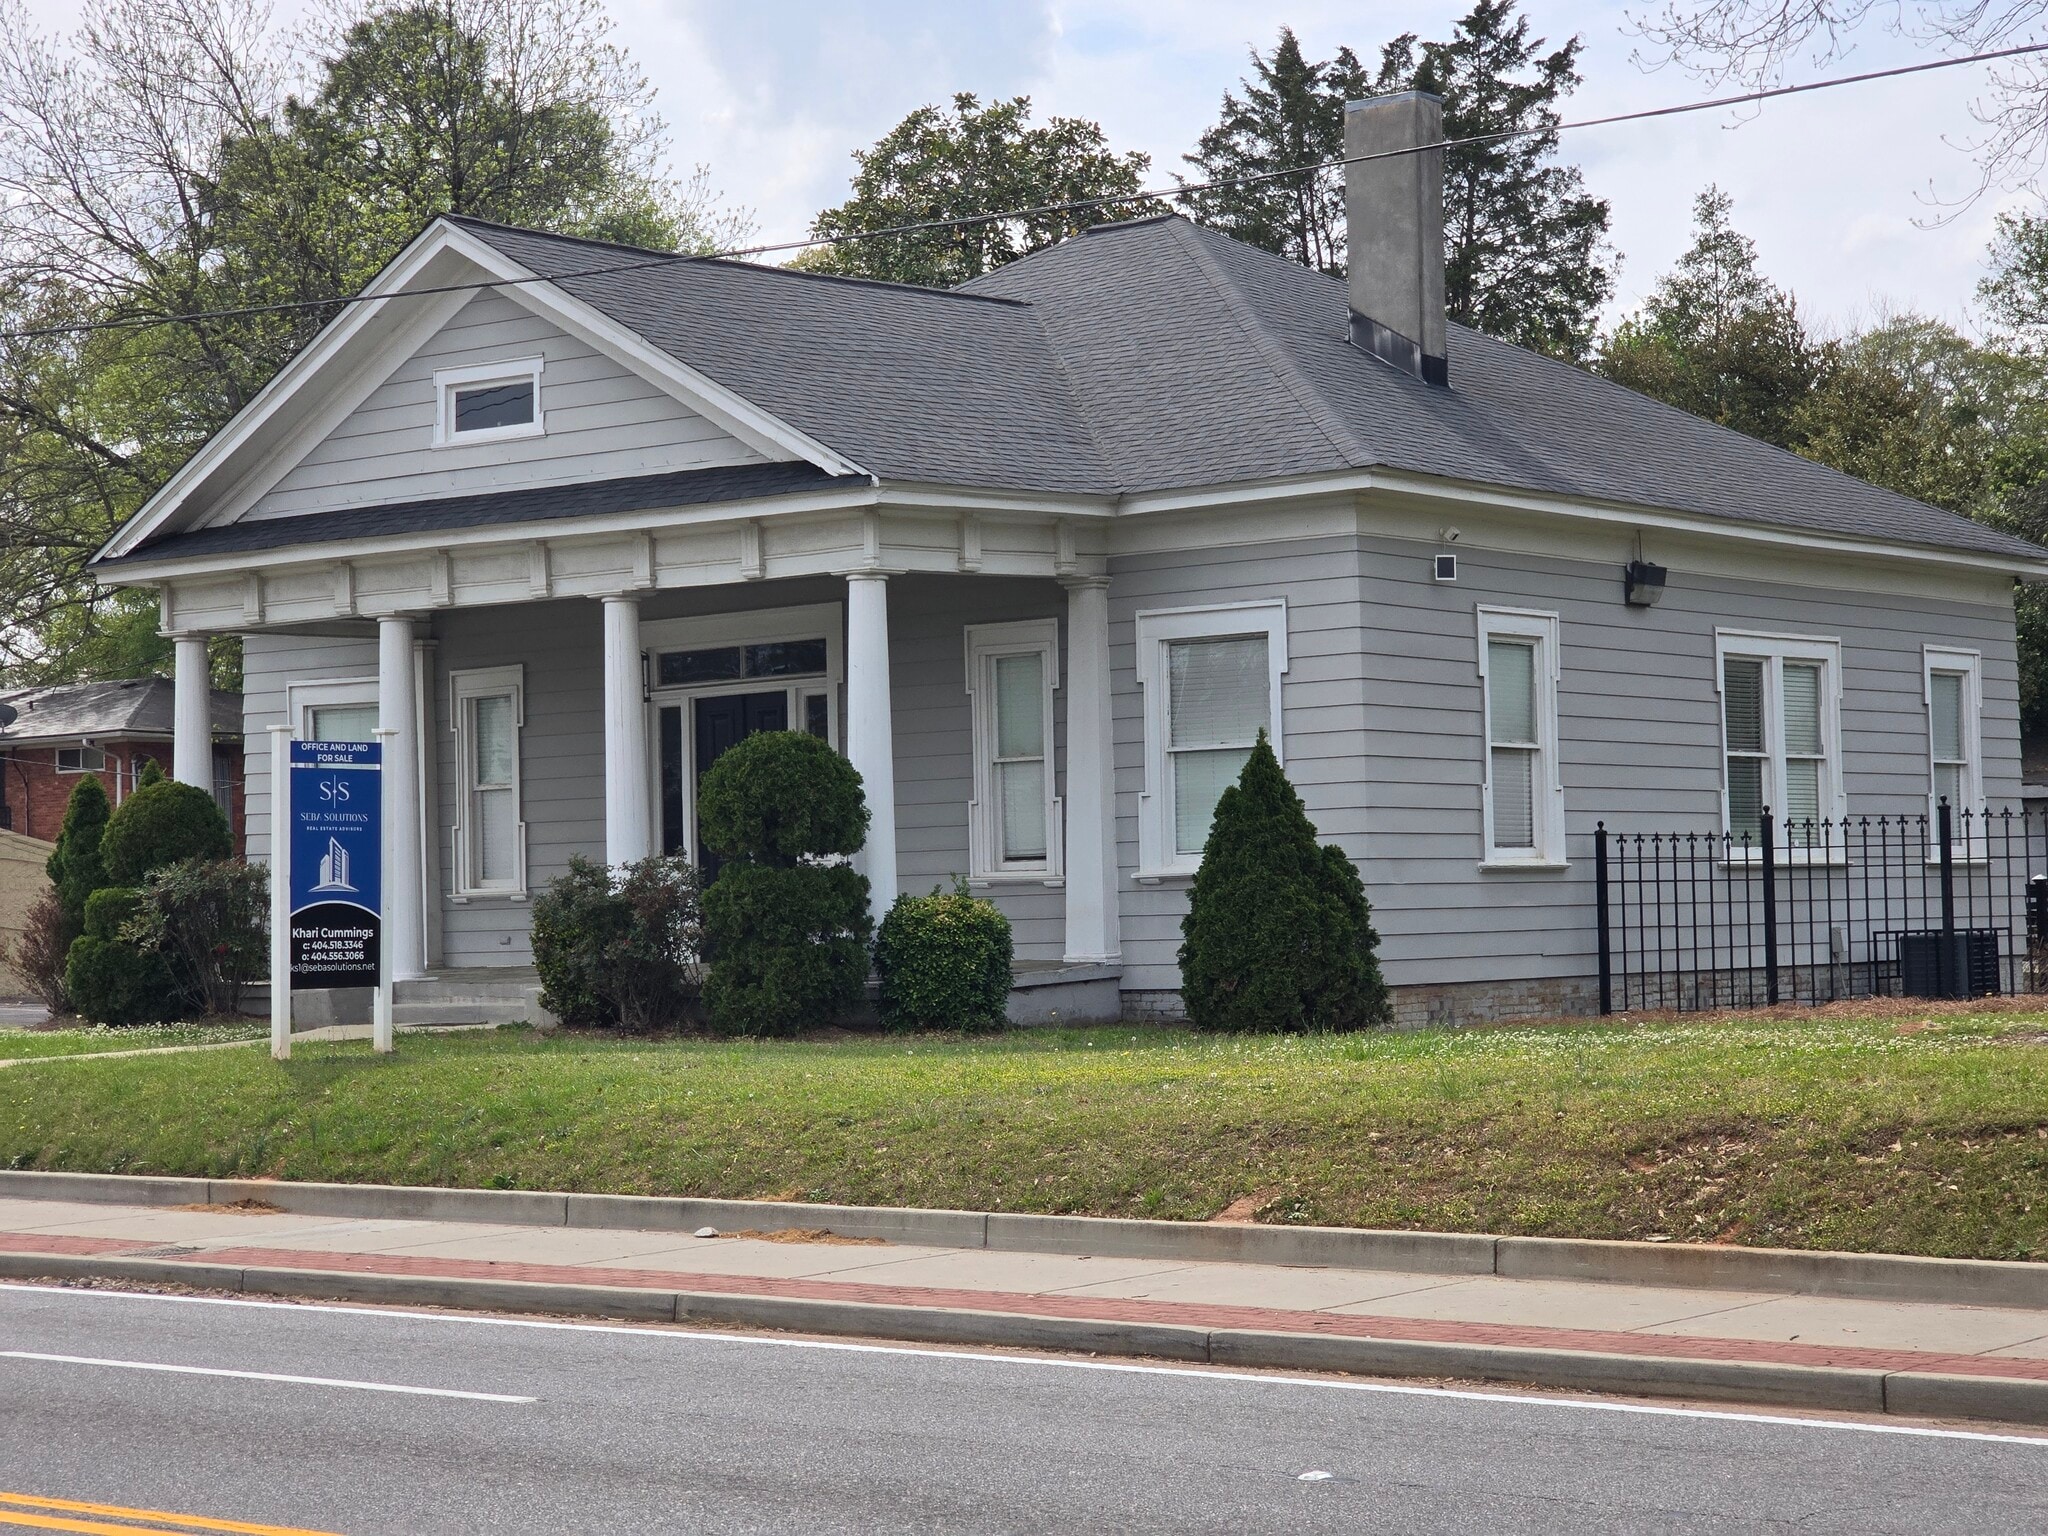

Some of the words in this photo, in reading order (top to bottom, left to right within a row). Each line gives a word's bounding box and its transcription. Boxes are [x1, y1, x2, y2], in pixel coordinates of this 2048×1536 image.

[301, 743, 328, 751] OFFICE
[330, 743, 346, 751] AND
[347, 744, 368, 752] LAND
[317, 754, 333, 762] FOR
[334, 754, 353, 762] SALE
[323, 812, 368, 822] SOLUTIONS
[292, 927, 319, 938] Khari
[321, 927, 374, 940] Cummings
[302, 942, 310, 950] c:
[312, 940, 364, 950] 404.518.3346
[301, 953, 310, 961] o:
[311, 951, 364, 961] 404.556.3066
